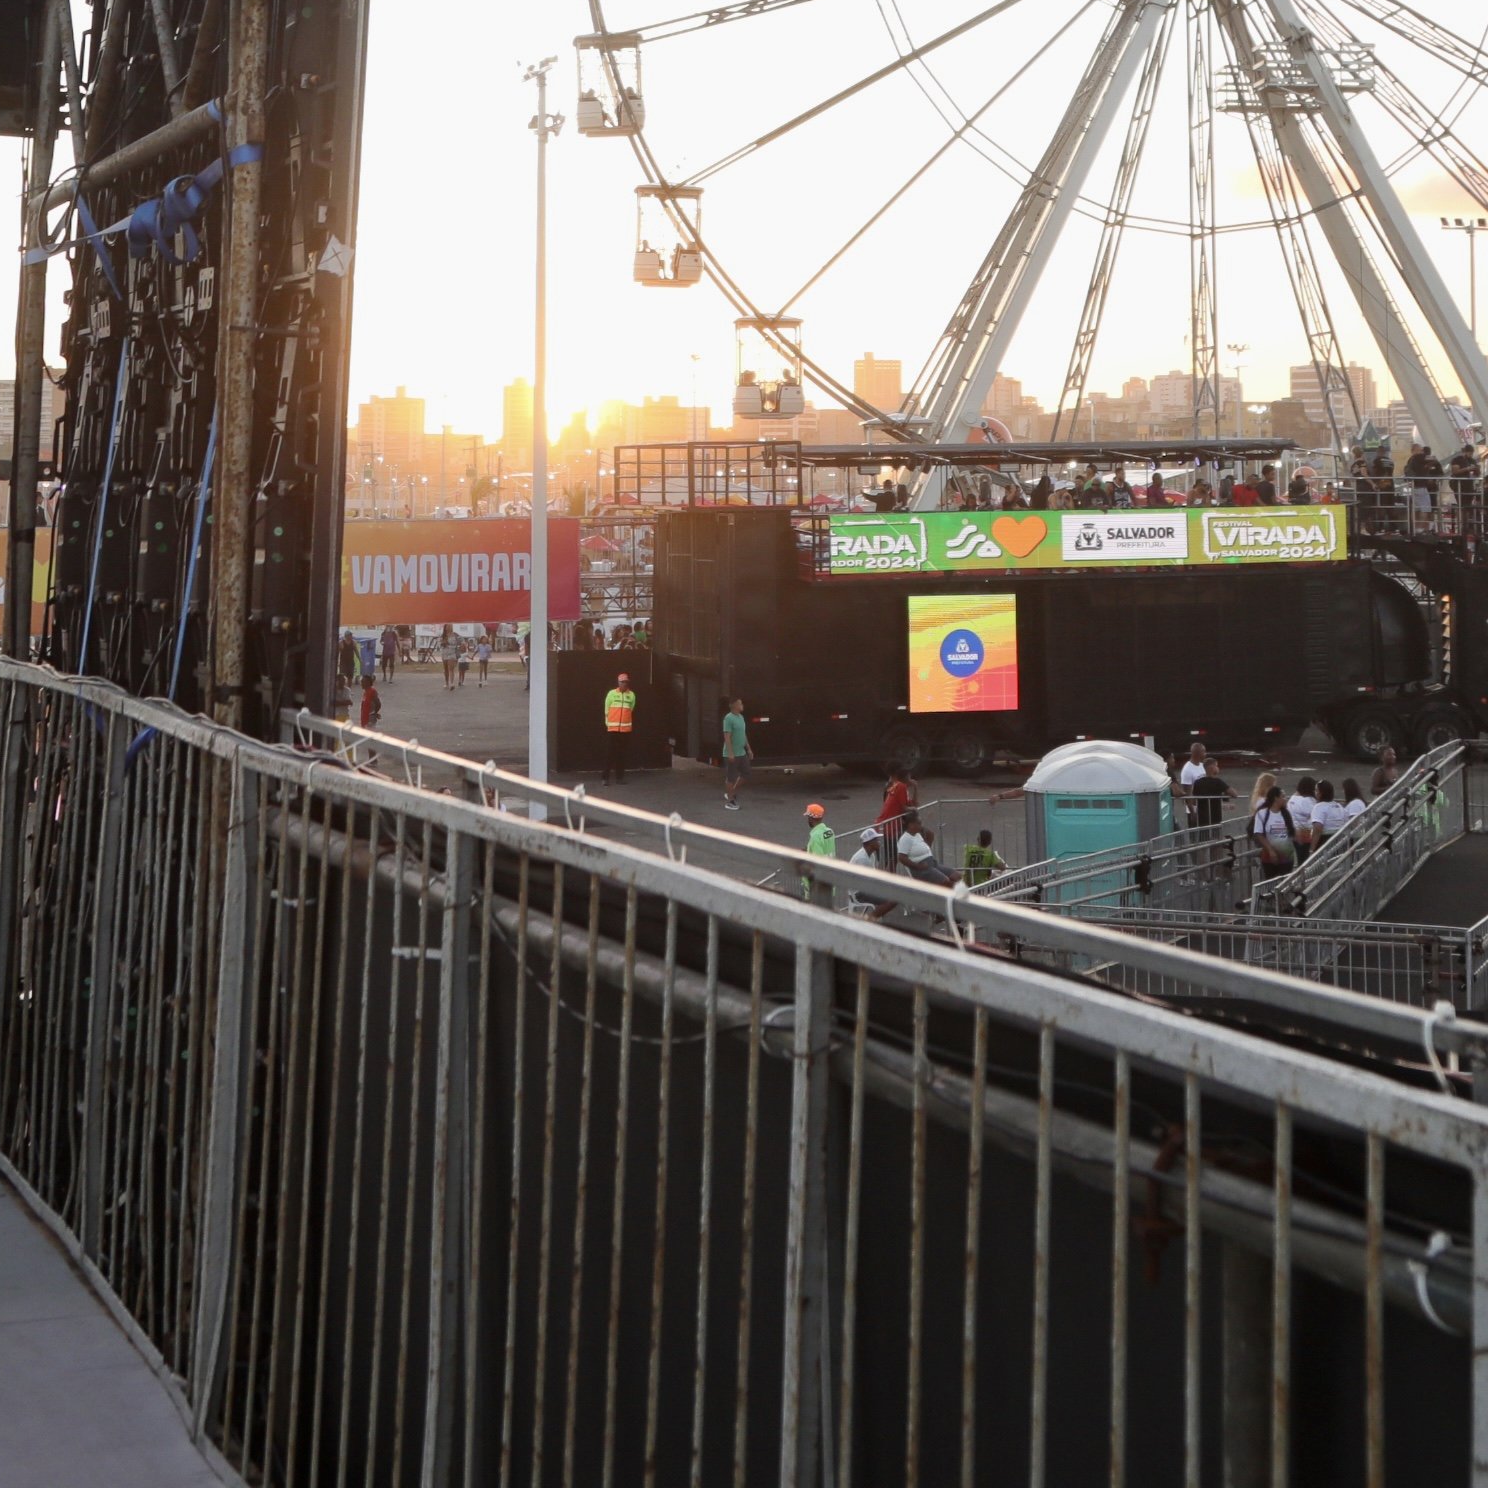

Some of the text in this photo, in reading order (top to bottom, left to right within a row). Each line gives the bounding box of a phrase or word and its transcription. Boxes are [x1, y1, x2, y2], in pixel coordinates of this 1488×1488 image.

[1213, 520, 1252, 528] FESTIVAL
[1107, 527, 1175, 541] SALVADOR
[1213, 525, 1327, 546] VIRADA
[1116, 541, 1166, 549] PREFEITURA
[1220, 546, 1328, 559] SALVADOR 2024
[865, 556, 917, 569] 2024
[947, 653, 979, 661] SALVADOR
